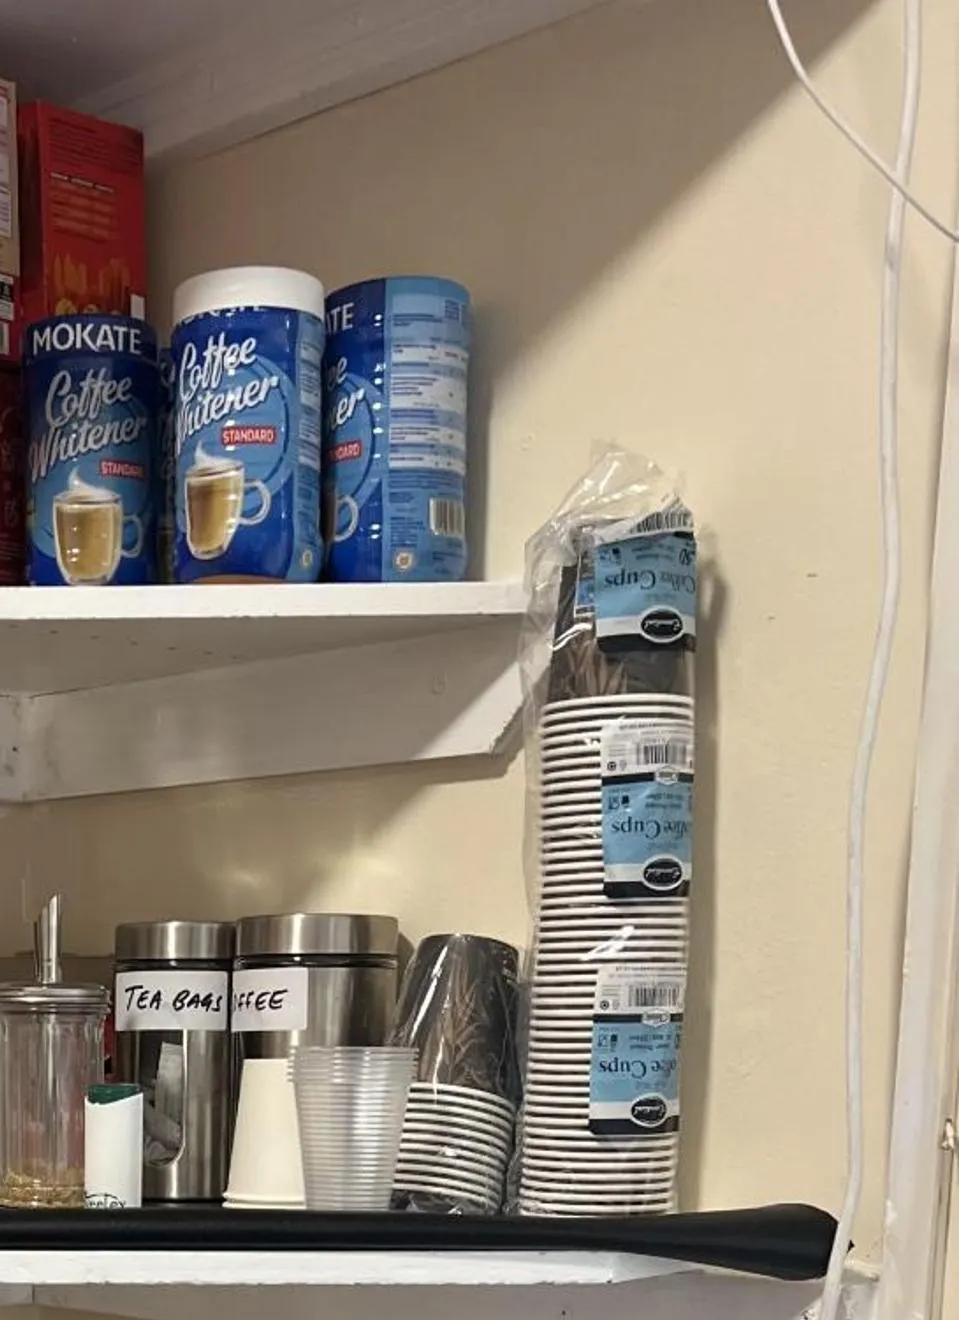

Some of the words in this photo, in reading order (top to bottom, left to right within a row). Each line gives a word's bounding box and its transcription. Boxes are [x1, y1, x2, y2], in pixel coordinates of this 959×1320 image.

[32, 322, 142, 357] MOKATE
[179, 331, 257, 401] Coffee
[45, 367, 133, 428] Coffee
[221, 428, 275, 444] STANDARD
[27, 417, 148, 485] Whitener
[604, 568, 657, 591] Cups
[610, 815, 661, 841] Cups
[125, 984, 162, 1012] TEA
[171, 989, 223, 1013] BAGS
[598, 1058, 647, 1081] Cups
